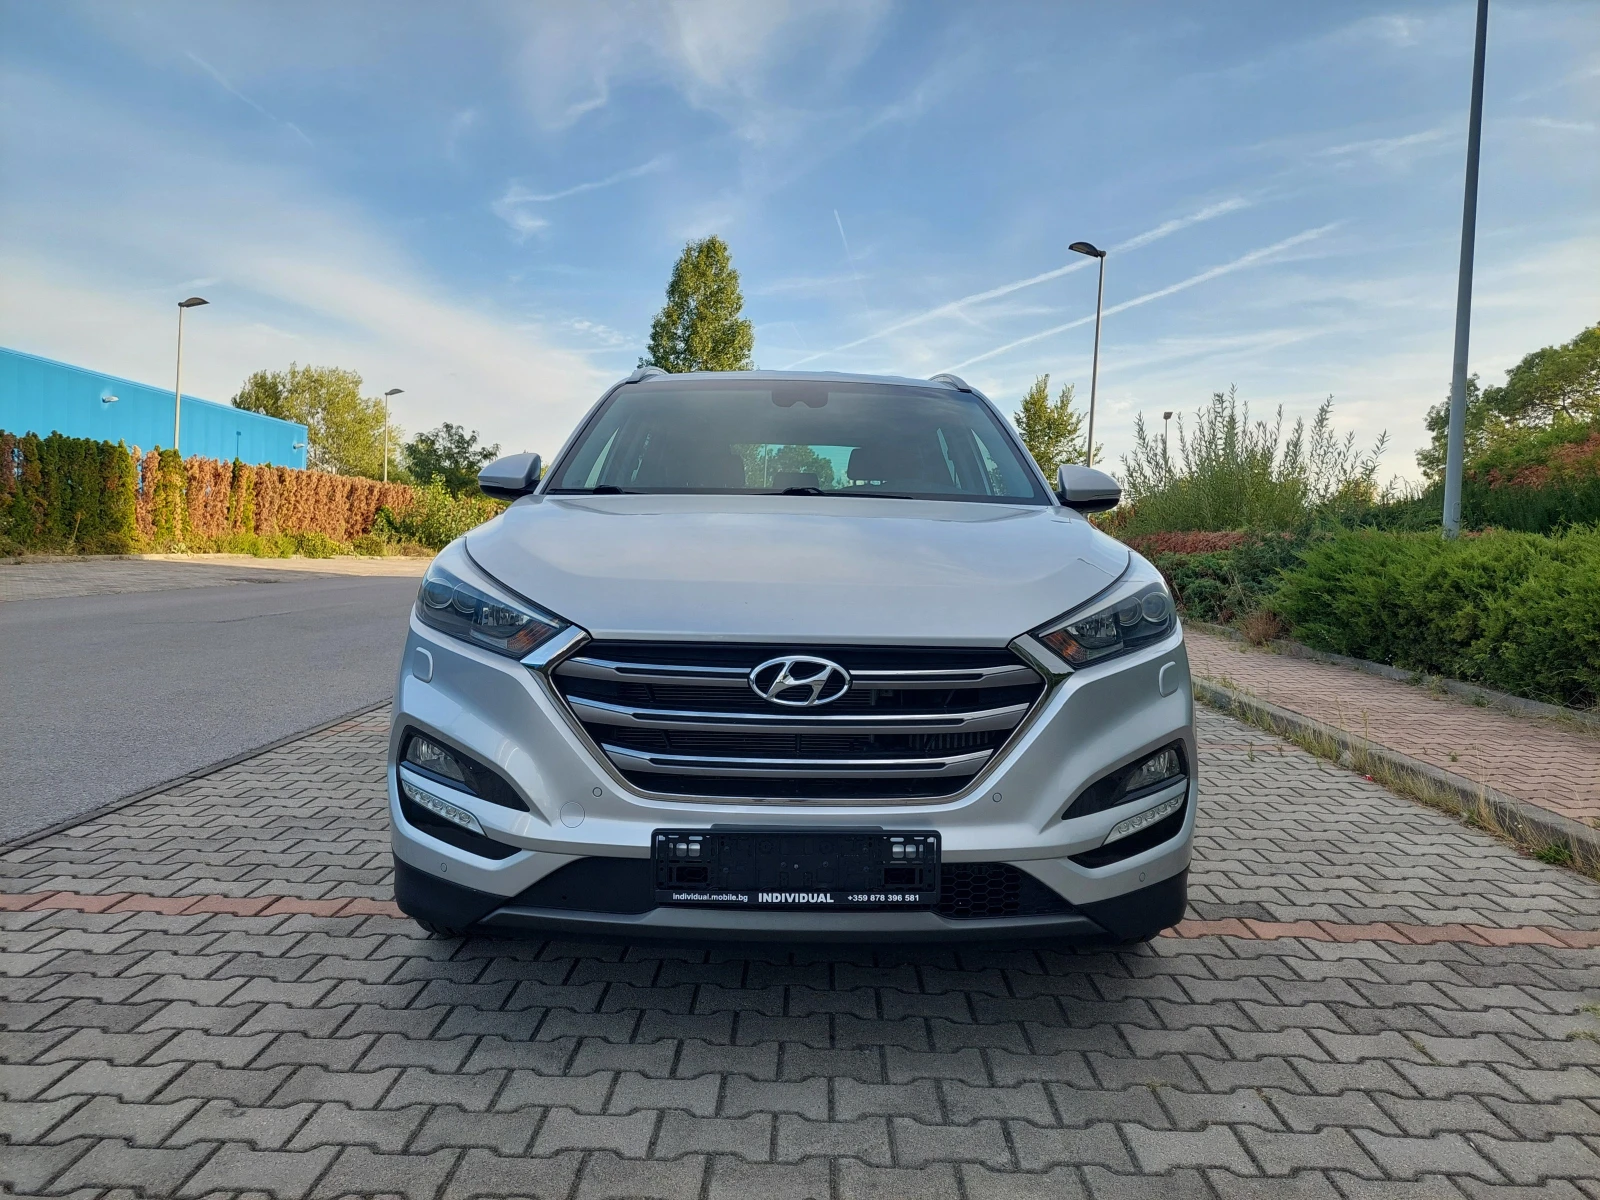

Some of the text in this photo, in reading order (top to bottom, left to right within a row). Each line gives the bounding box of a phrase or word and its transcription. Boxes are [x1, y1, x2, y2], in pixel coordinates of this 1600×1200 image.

[758, 892, 834, 903] INDIVIDUAL
[847, 894, 919, 902] +359 878 396 581
